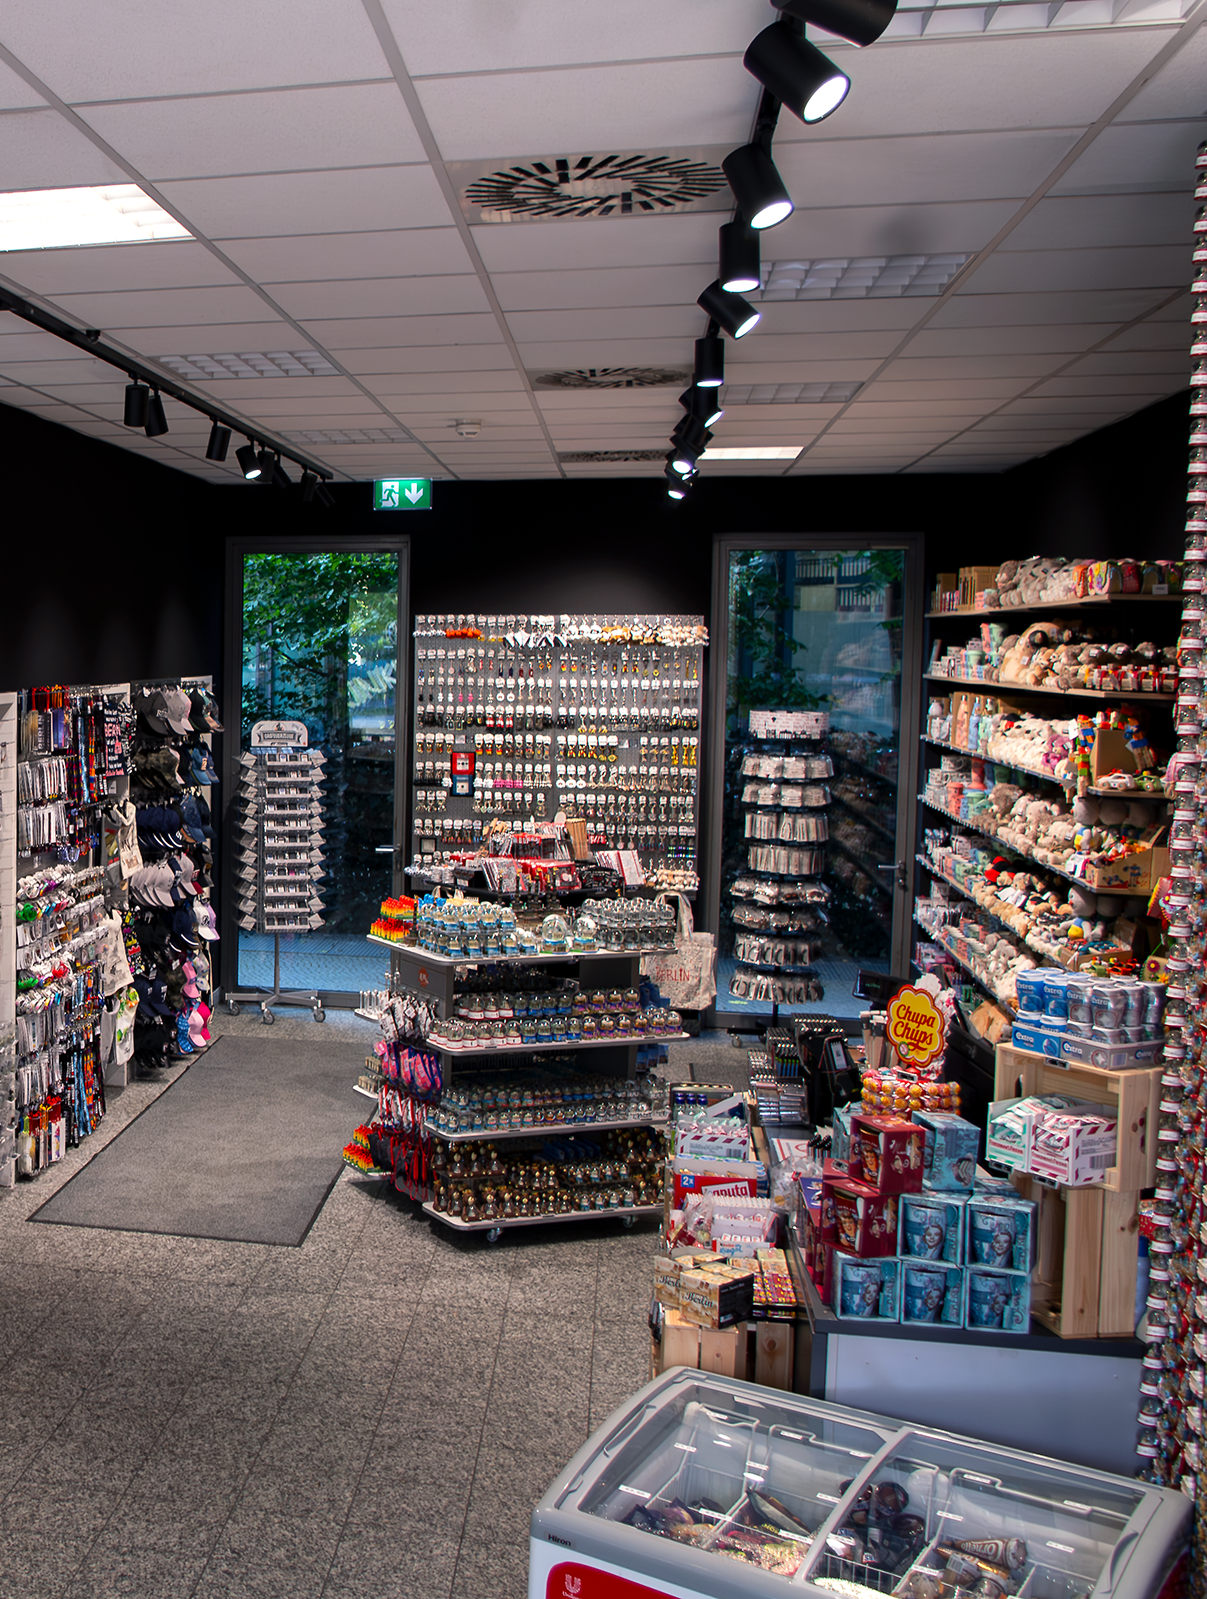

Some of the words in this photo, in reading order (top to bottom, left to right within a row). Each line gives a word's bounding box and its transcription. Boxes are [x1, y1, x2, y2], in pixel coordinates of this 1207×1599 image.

[655, 966, 690, 982] BERLIN
[896, 1004, 936, 1028] Chupa
[893, 1020, 934, 1048] Chups
[682, 1176, 694, 1186] 2x
[548, 1534, 571, 1546] Hiron
